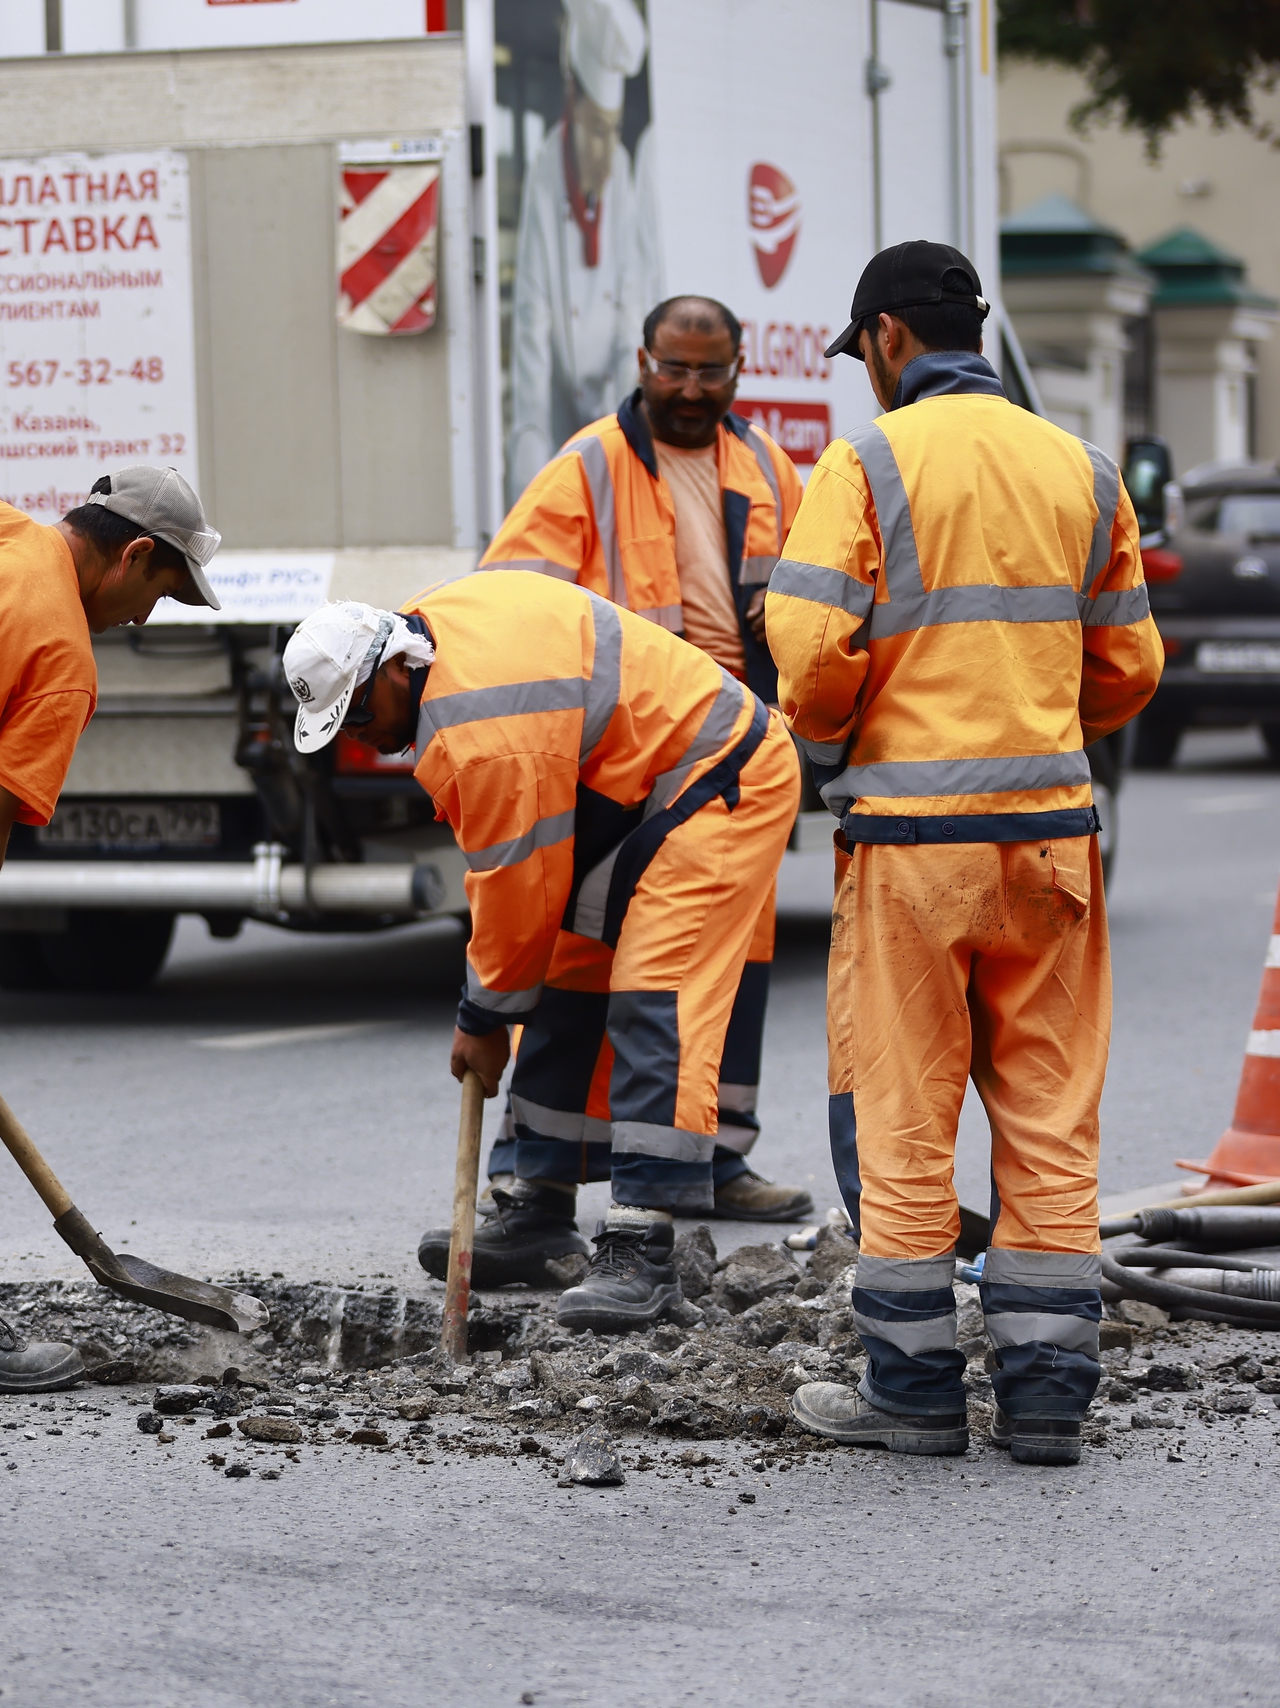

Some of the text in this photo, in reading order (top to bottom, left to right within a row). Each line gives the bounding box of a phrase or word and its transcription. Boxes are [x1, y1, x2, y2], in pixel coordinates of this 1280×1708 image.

[8, 356, 164, 387] 567-32-48
[13, 411, 101, 433] Казань,
[86, 440, 150, 460] тракт
[158, 434, 186, 454] 32
